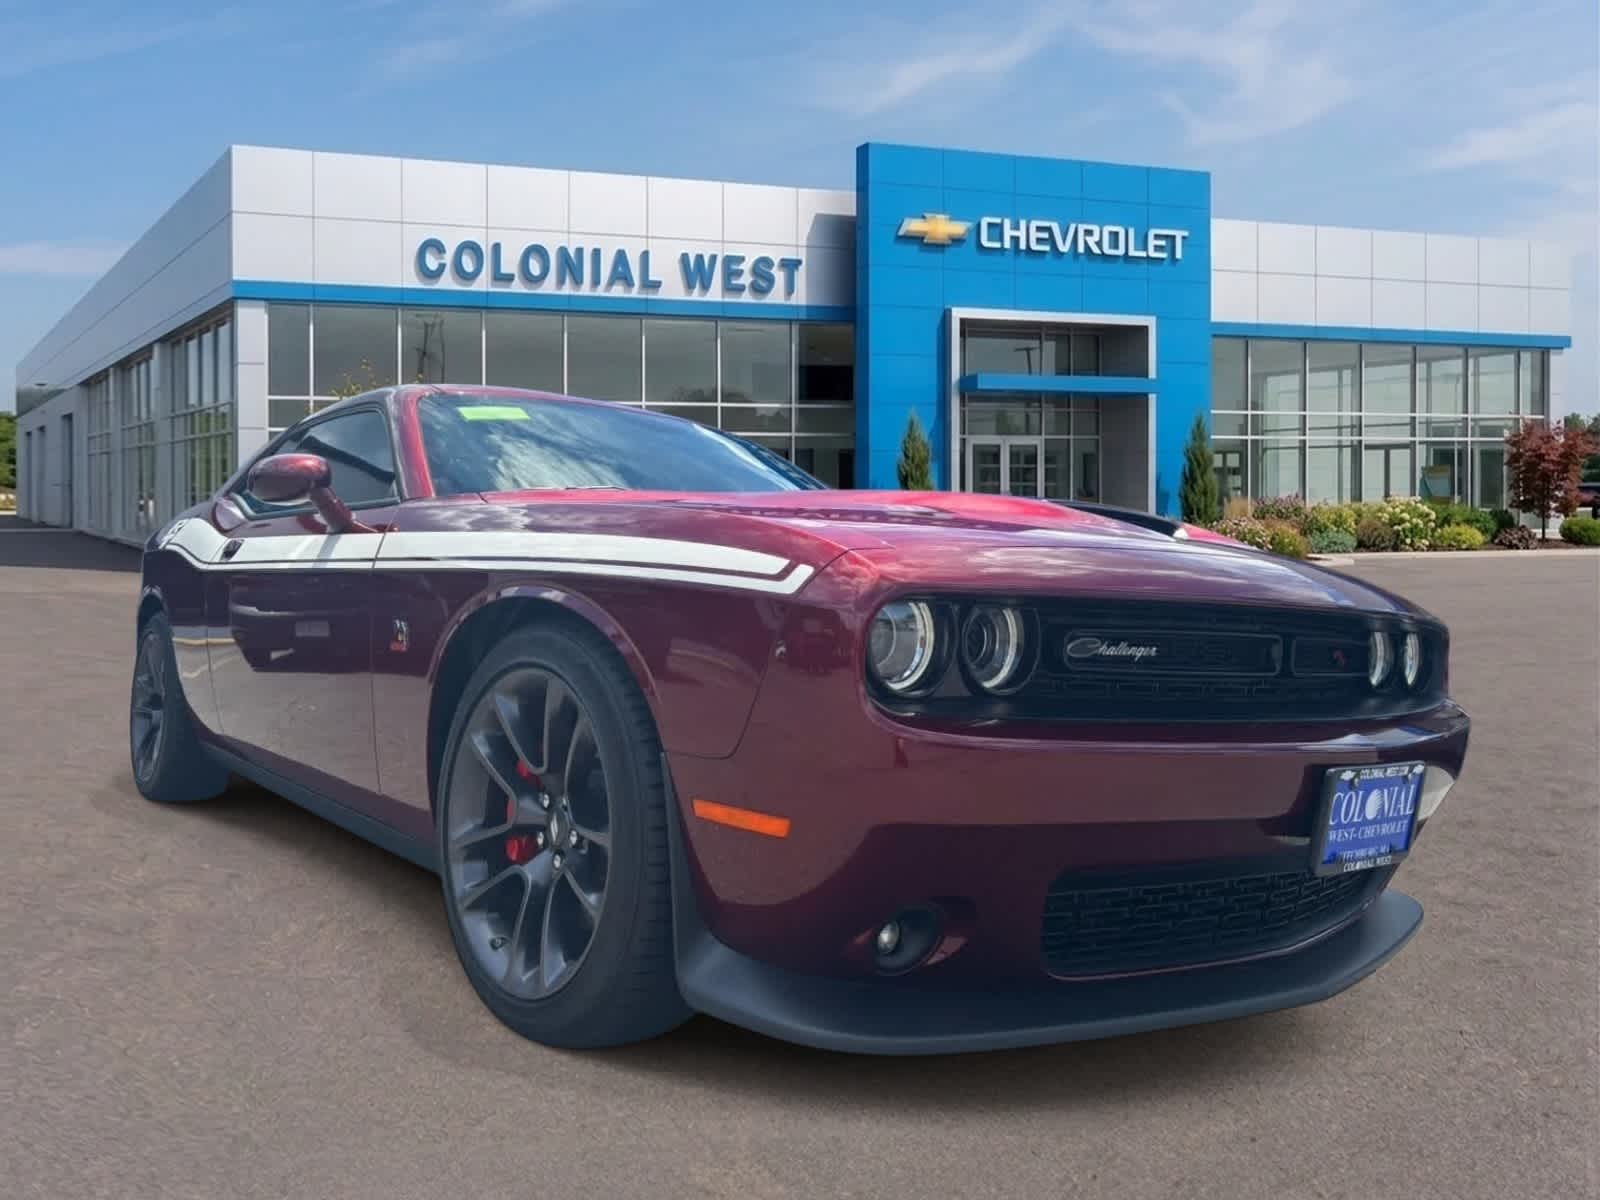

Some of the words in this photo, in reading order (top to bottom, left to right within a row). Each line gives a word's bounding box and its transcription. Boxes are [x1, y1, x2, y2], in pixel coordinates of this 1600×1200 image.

[979, 216, 1189, 261] CHEVROLET
[415, 237, 663, 292] COLONIAL
[679, 252, 803, 302] WEST
[1066, 637, 1159, 661] Challenger
